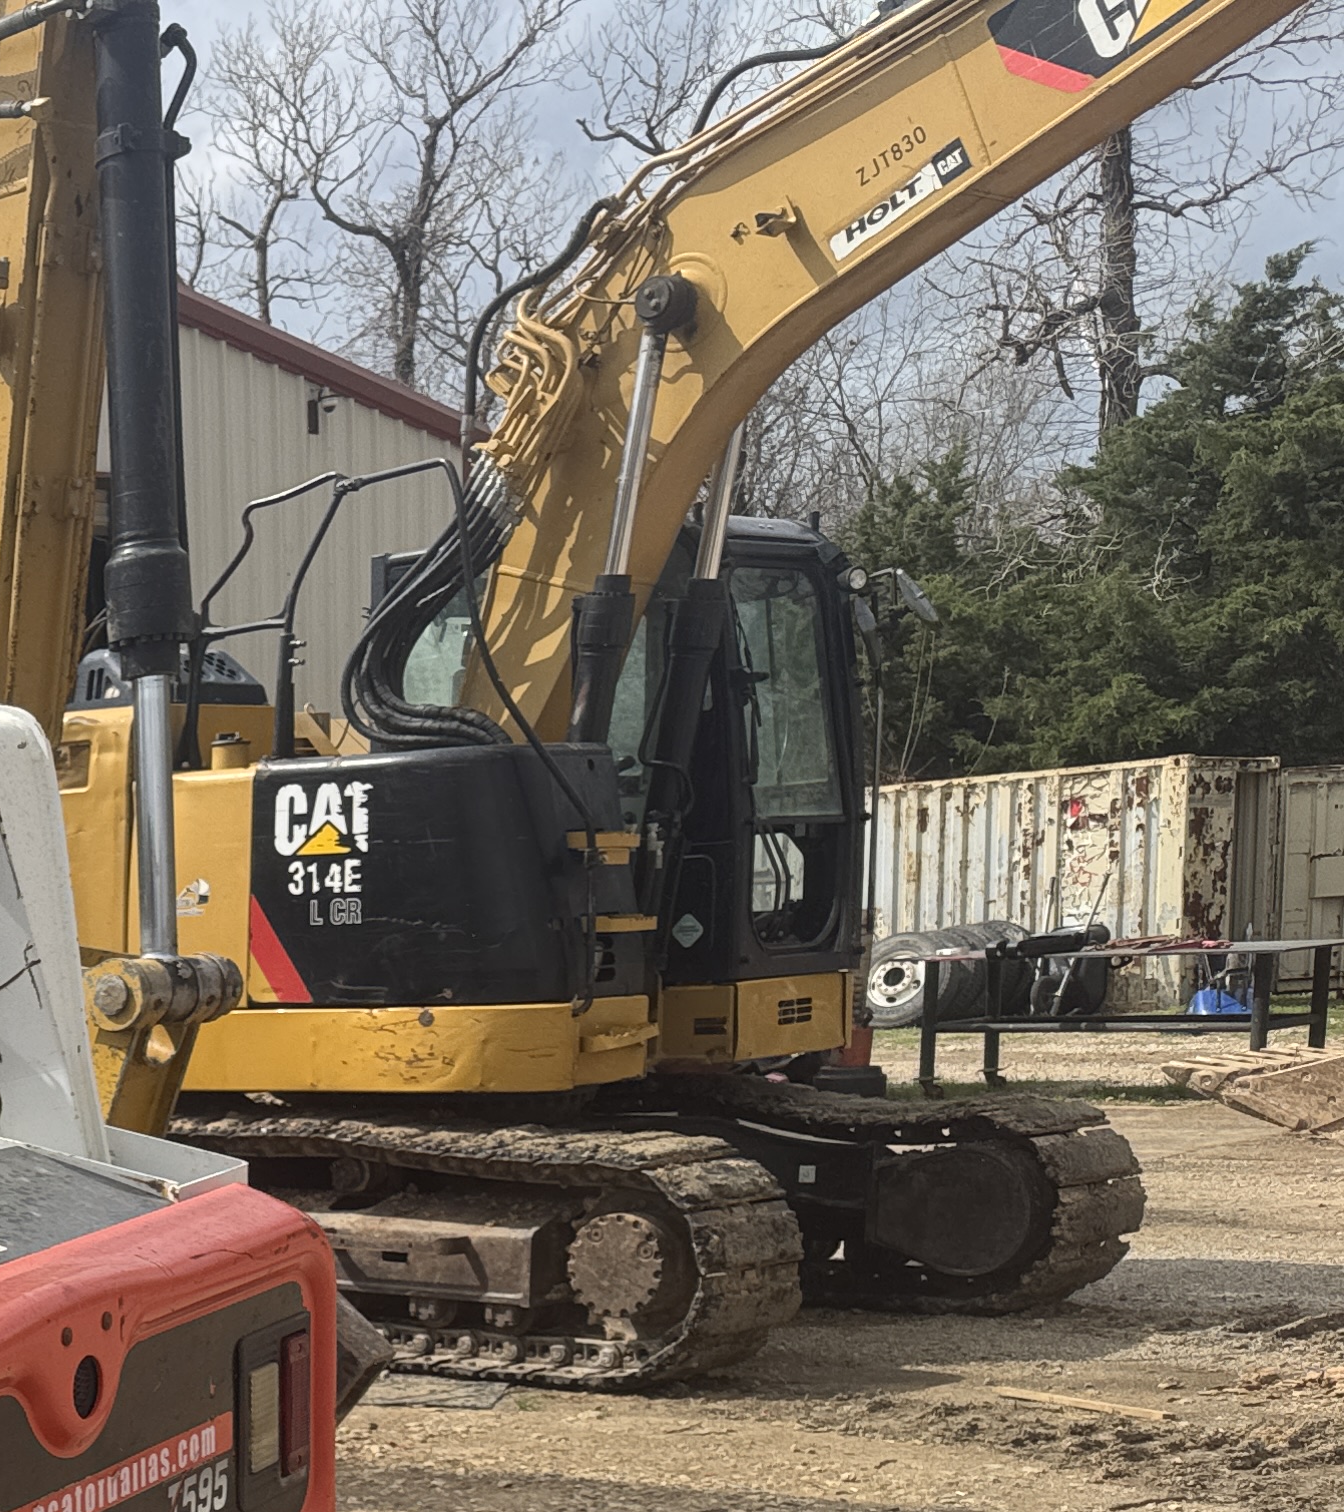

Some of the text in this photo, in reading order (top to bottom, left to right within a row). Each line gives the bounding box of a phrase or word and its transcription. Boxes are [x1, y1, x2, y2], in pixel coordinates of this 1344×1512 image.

[855, 126, 927, 187] ZJT830
[845, 147, 963, 243] HOLT CAT
[274, 781, 373, 856] CAT
[288, 859, 362, 896] 314E
[309, 898, 362, 926] L CR
